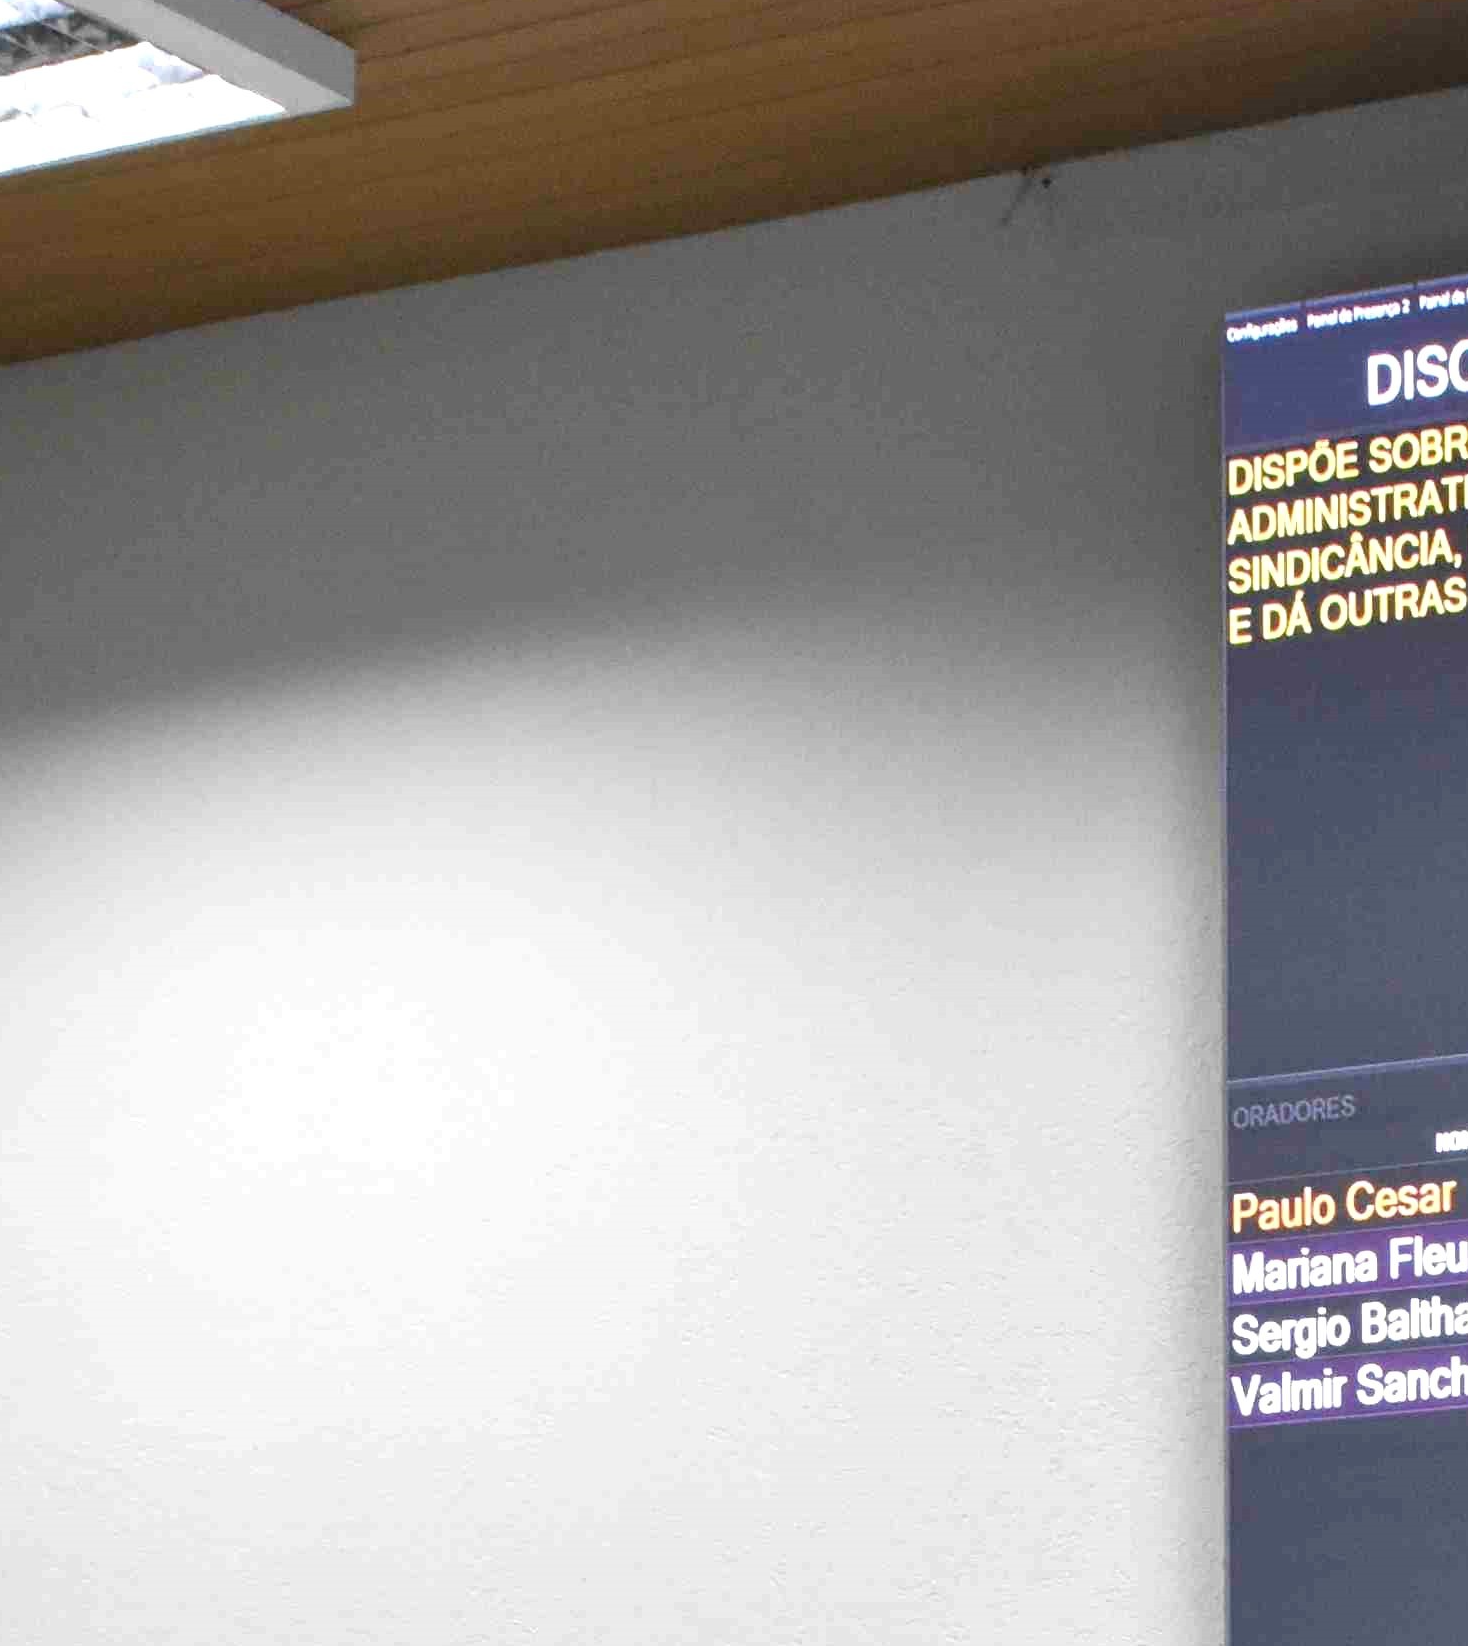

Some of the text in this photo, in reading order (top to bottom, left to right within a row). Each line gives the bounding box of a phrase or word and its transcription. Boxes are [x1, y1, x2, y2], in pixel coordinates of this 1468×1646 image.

[1228, 439, 1359, 497] DISPÕE
[1228, 530, 1462, 595] SINDICÂNCIA,
[1229, 606, 1253, 645] E
[1262, 593, 1312, 641] DÁ
[1319, 575, 1468, 630] OUTRAS
[1232, 1094, 1356, 1129] ORADORES
[1232, 1186, 1337, 1234] Paulo
[1345, 1178, 1458, 1222] Cesar
[1232, 1247, 1378, 1296] Mariana
[1232, 1307, 1351, 1360] Sergio
[1230, 1366, 1348, 1417] Valmir
